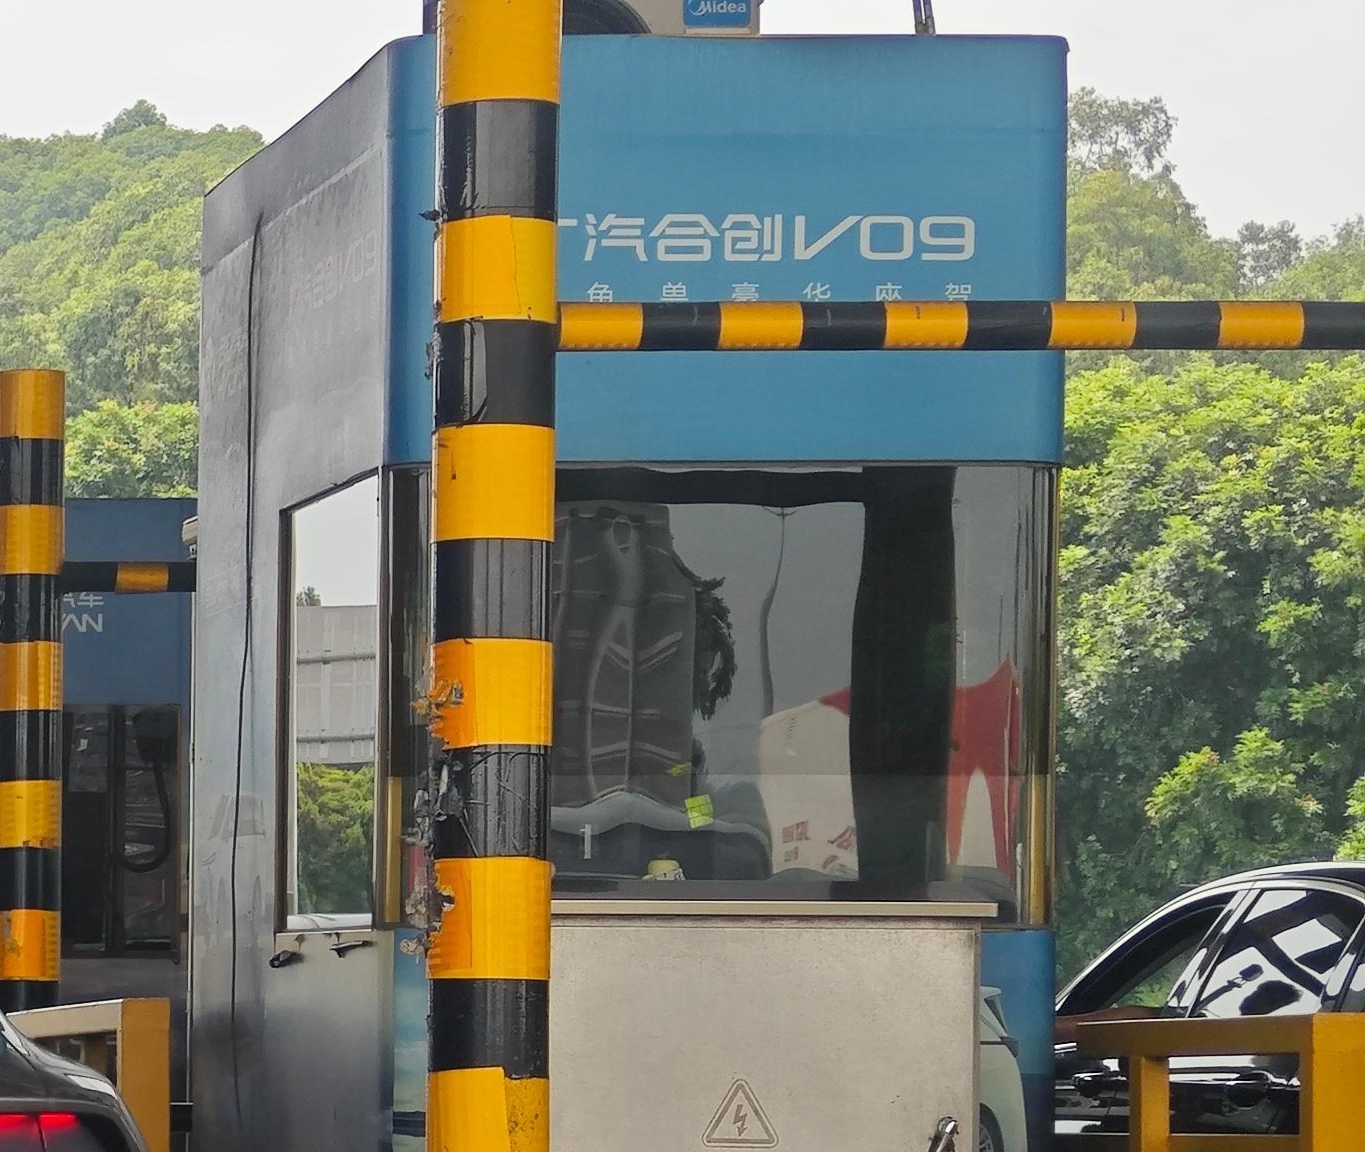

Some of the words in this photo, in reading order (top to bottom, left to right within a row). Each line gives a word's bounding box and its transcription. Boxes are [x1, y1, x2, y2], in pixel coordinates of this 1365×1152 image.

[693, 0, 746, 15] Midea
[557, 213, 975, 262] 汽合创V09
